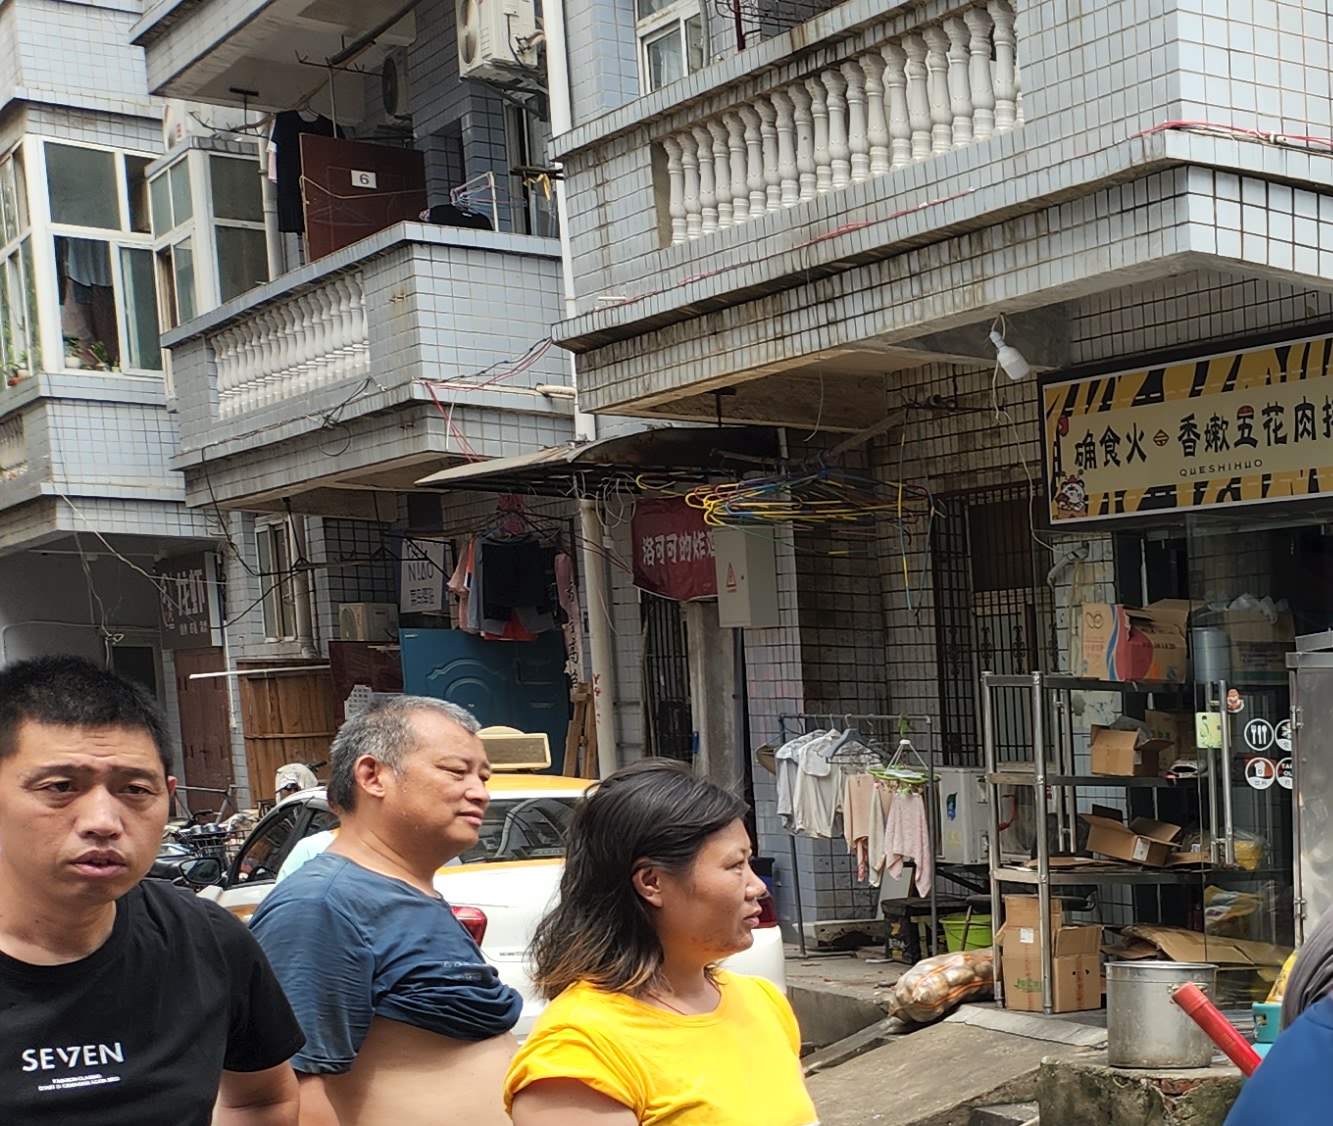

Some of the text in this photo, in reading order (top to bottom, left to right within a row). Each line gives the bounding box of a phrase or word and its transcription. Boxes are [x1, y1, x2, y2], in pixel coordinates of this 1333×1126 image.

[360, 173, 370, 185] 6
[1074, 422, 1147, 471] 确食火
[22, 1042, 124, 1072] SEVEN
